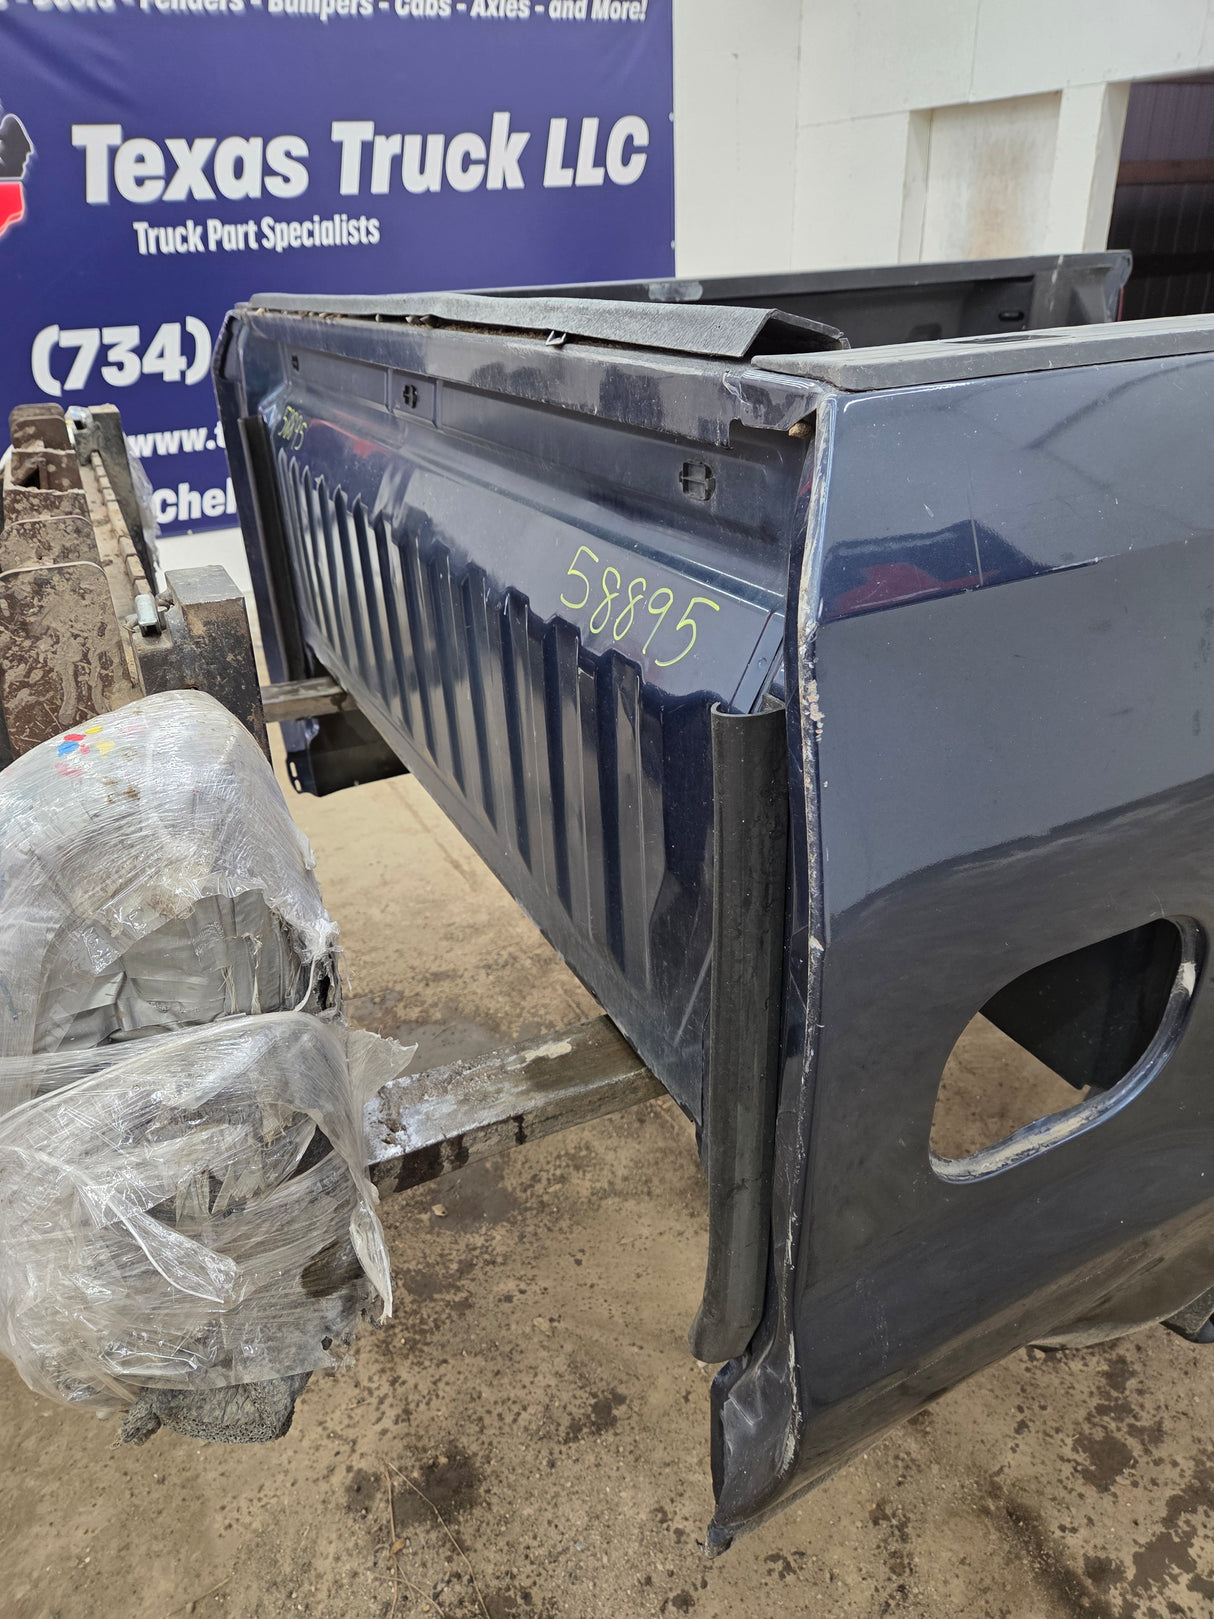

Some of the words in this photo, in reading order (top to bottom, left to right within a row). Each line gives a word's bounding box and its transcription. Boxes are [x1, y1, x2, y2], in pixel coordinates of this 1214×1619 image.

[469, 0, 531, 18] Axles
[548, 0, 588, 19] and
[590, 0, 648, 20] More!
[71, 123, 310, 204] Texas
[331, 111, 531, 195] Truck
[543, 114, 650, 188] LLC
[132, 219, 206, 255] Truck
[206, 218, 259, 251] Part
[260, 213, 381, 253] Specialists
[31, 316, 212, 397] (734)
[559, 545, 720, 667] 58895
